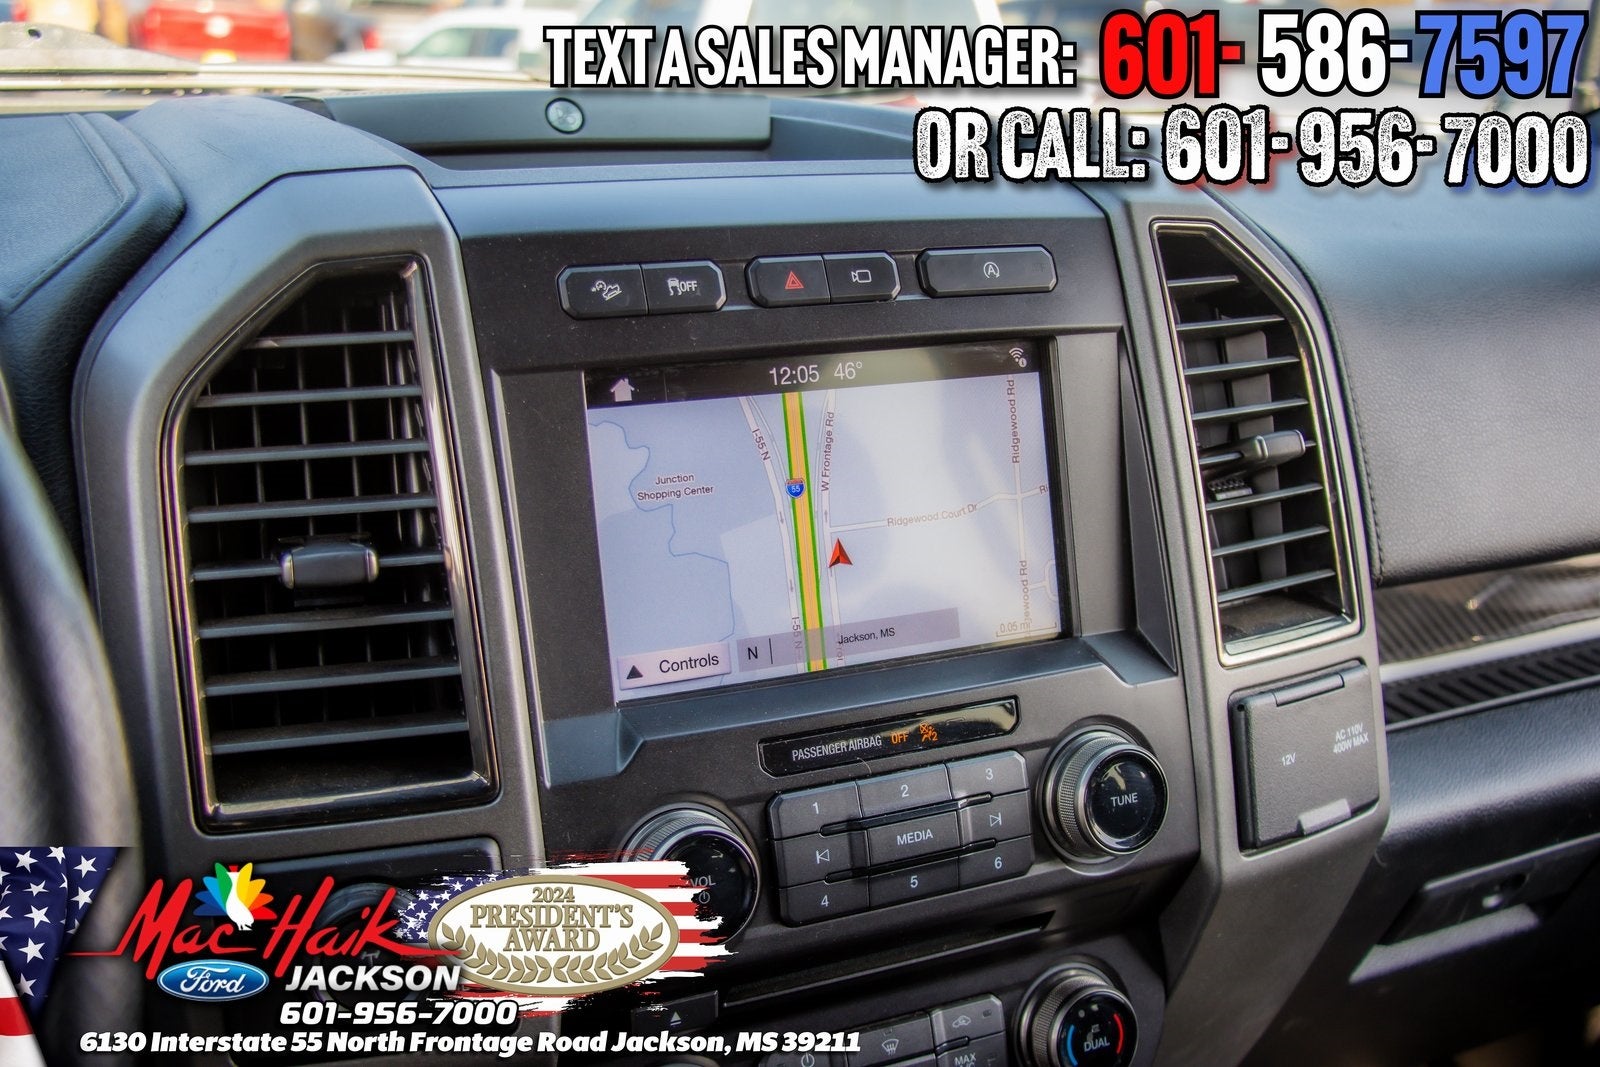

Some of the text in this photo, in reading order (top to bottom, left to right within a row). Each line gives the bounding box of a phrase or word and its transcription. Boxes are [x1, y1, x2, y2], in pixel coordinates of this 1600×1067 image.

[679, 281, 698, 292] OFF
[769, 360, 863, 386] 12:05 46°
[1006, 379, 1021, 464] Ridgewood Rd
[752, 428, 771, 461] I-55 N
[821, 412, 835, 492] W Frontage Rd
[655, 473, 695, 485] Junction
[637, 485, 715, 502] Shopping Center
[791, 485, 801, 493] 55
[887, 503, 978, 527] Ridgewood Court Dr
[1019, 560, 1028, 576] Rd
[1000, 621, 1018, 634] 0.05
[838, 627, 896, 645] Jackson, MS
[747, 646, 759, 660] N
[659, 653, 720, 674] Controls
[1335, 722, 1364, 742] AC 110V
[791, 731, 909, 762] PASSENGER AIRBAG OFF
[1333, 731, 1369, 754] 400W MAX
[1281, 752, 1297, 767] 12V
[985, 768, 994, 781] 3
[900, 784, 909, 798] 2
[1111, 792, 1139, 807] TUNE
[812, 802, 819, 815] 1
[896, 829, 934, 846] MEDIA
[994, 856, 1003, 869] 6
[691, 875, 717, 888] VOL
[909, 875, 919, 888] 5
[820, 895, 830, 907] 4
[1083, 1036, 1111, 1052] DUAL
[954, 1052, 977, 1066] MAX
